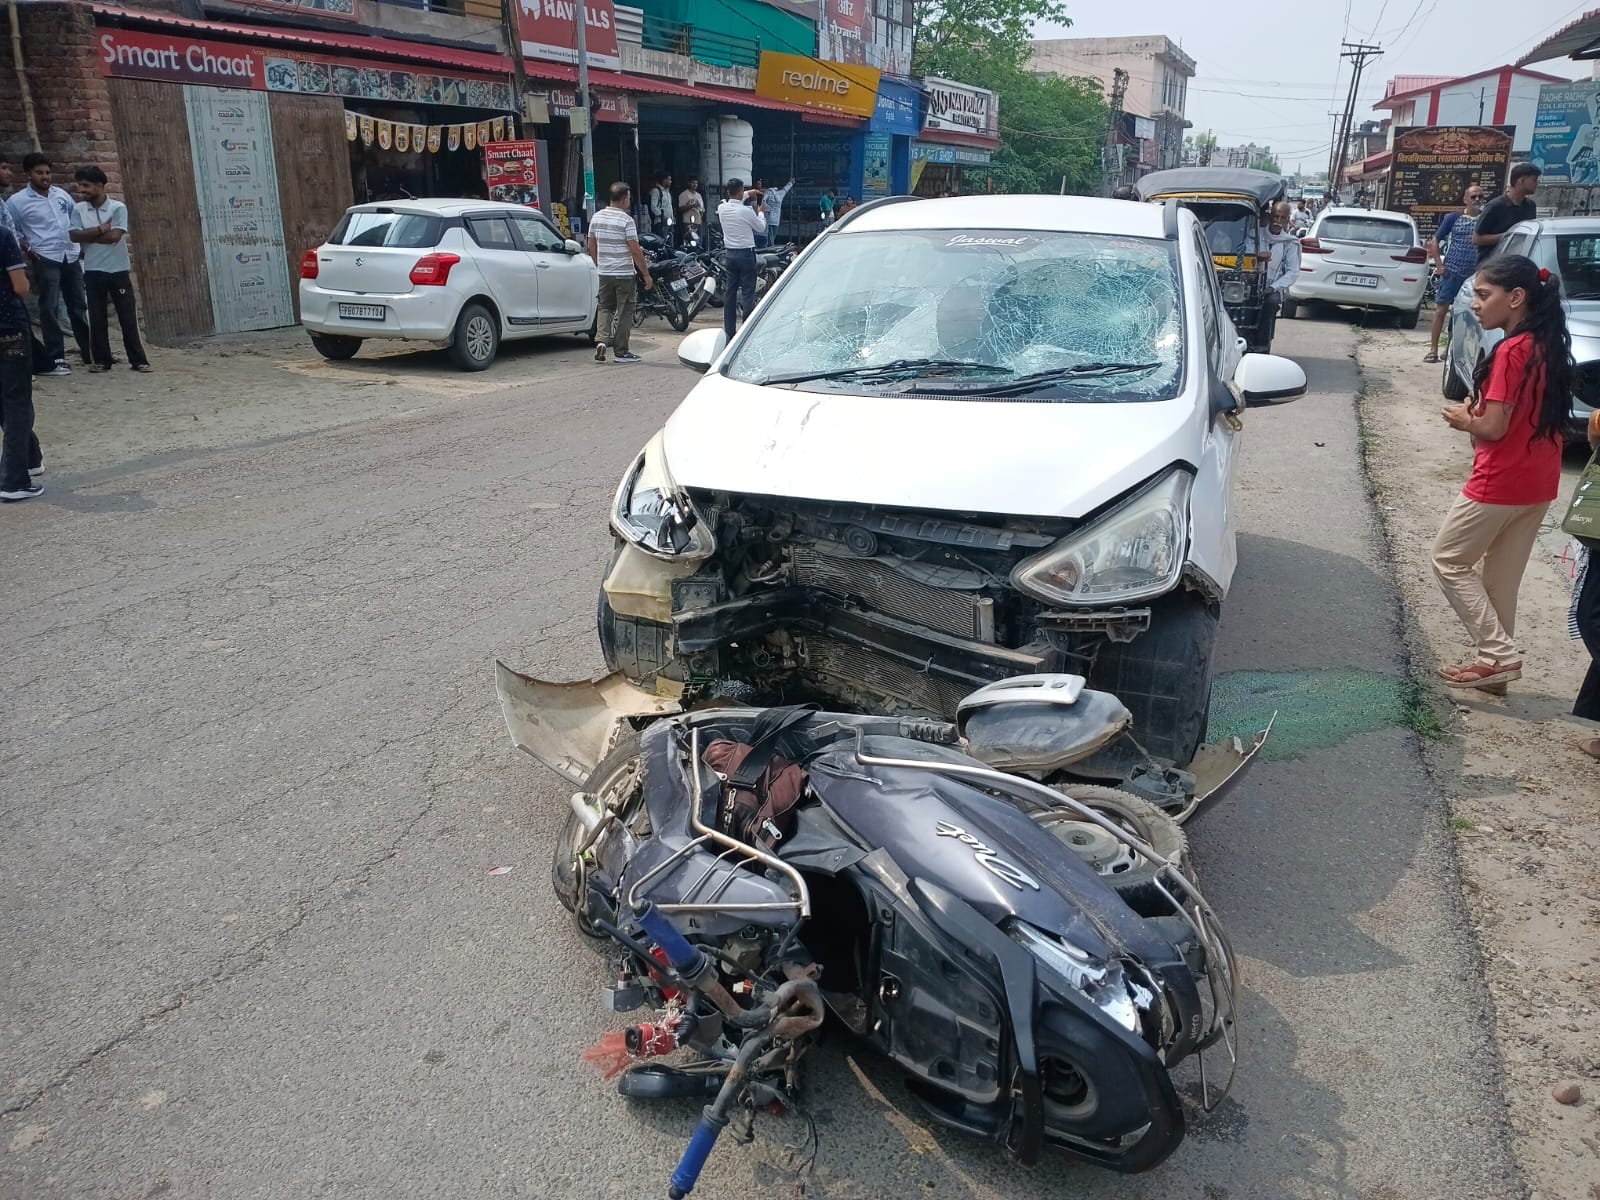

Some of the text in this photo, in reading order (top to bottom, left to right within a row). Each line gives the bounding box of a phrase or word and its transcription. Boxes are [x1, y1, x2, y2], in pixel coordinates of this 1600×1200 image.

[544, 0, 610, 30] HAVLLS
[101, 34, 256, 78] Smart Chaat
[781, 70, 850, 95] realme
[551, 89, 577, 107] Chaa
[1538, 102, 1586, 110] COLLECTION
[487, 148, 534, 159] Smart Chaat
[799, 143, 841, 153] TRADING
[864, 150, 887, 158] REPAIR
[945, 234, 1028, 246] Jaswal
[936, 819, 1040, 891] Duet
[1190, 1014, 1200, 1040] Hero
